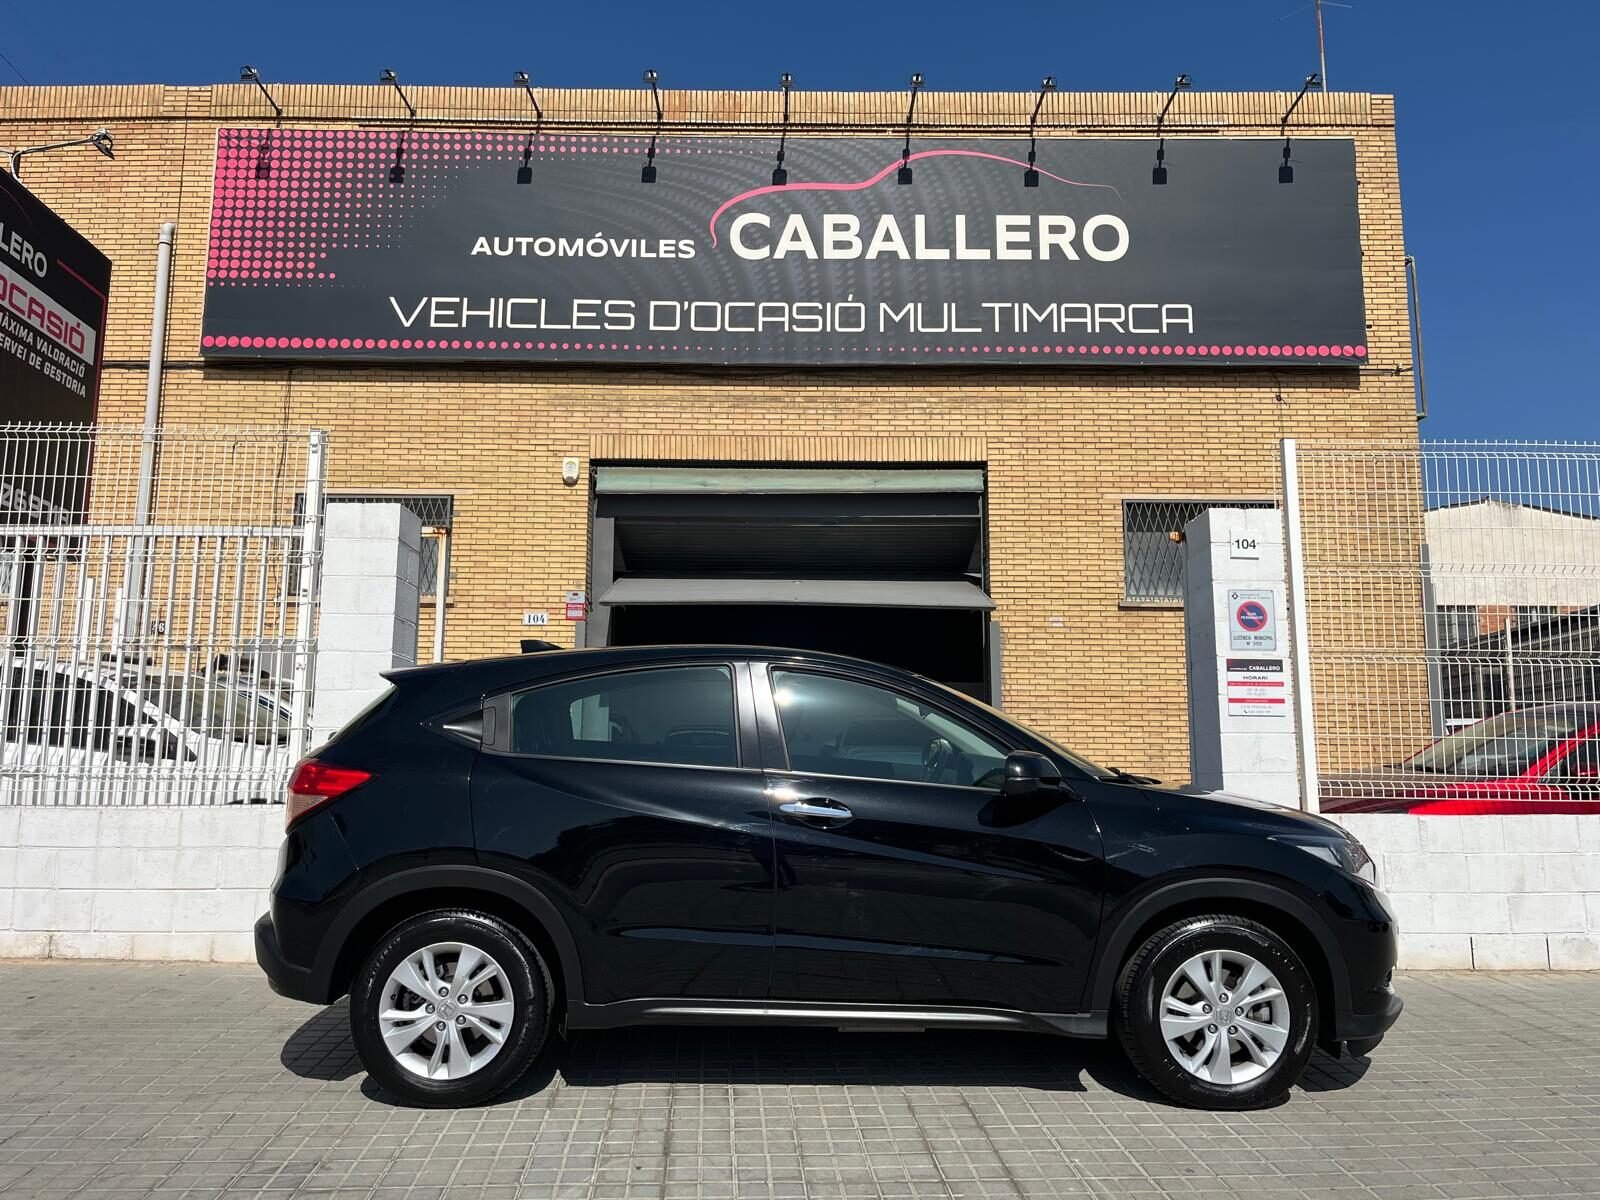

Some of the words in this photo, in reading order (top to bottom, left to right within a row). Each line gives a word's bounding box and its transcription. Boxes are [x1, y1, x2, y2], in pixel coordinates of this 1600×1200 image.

[0, 222, 47, 278] LERO
[471, 232, 695, 258] AUTOMÓVILES
[730, 213, 1129, 261] CABALLERO
[390, 297, 635, 330] VEHICLES
[648, 294, 865, 332] D'OCASIÓ
[880, 302, 1194, 334] MULTIMARCA
[28, 352, 42, 370] DE
[43, 361, 86, 398] GESTORIA
[36, 336, 86, 378] VALORACIÓ
[1234, 538, 1257, 549] 104
[528, 614, 545, 624] 104
